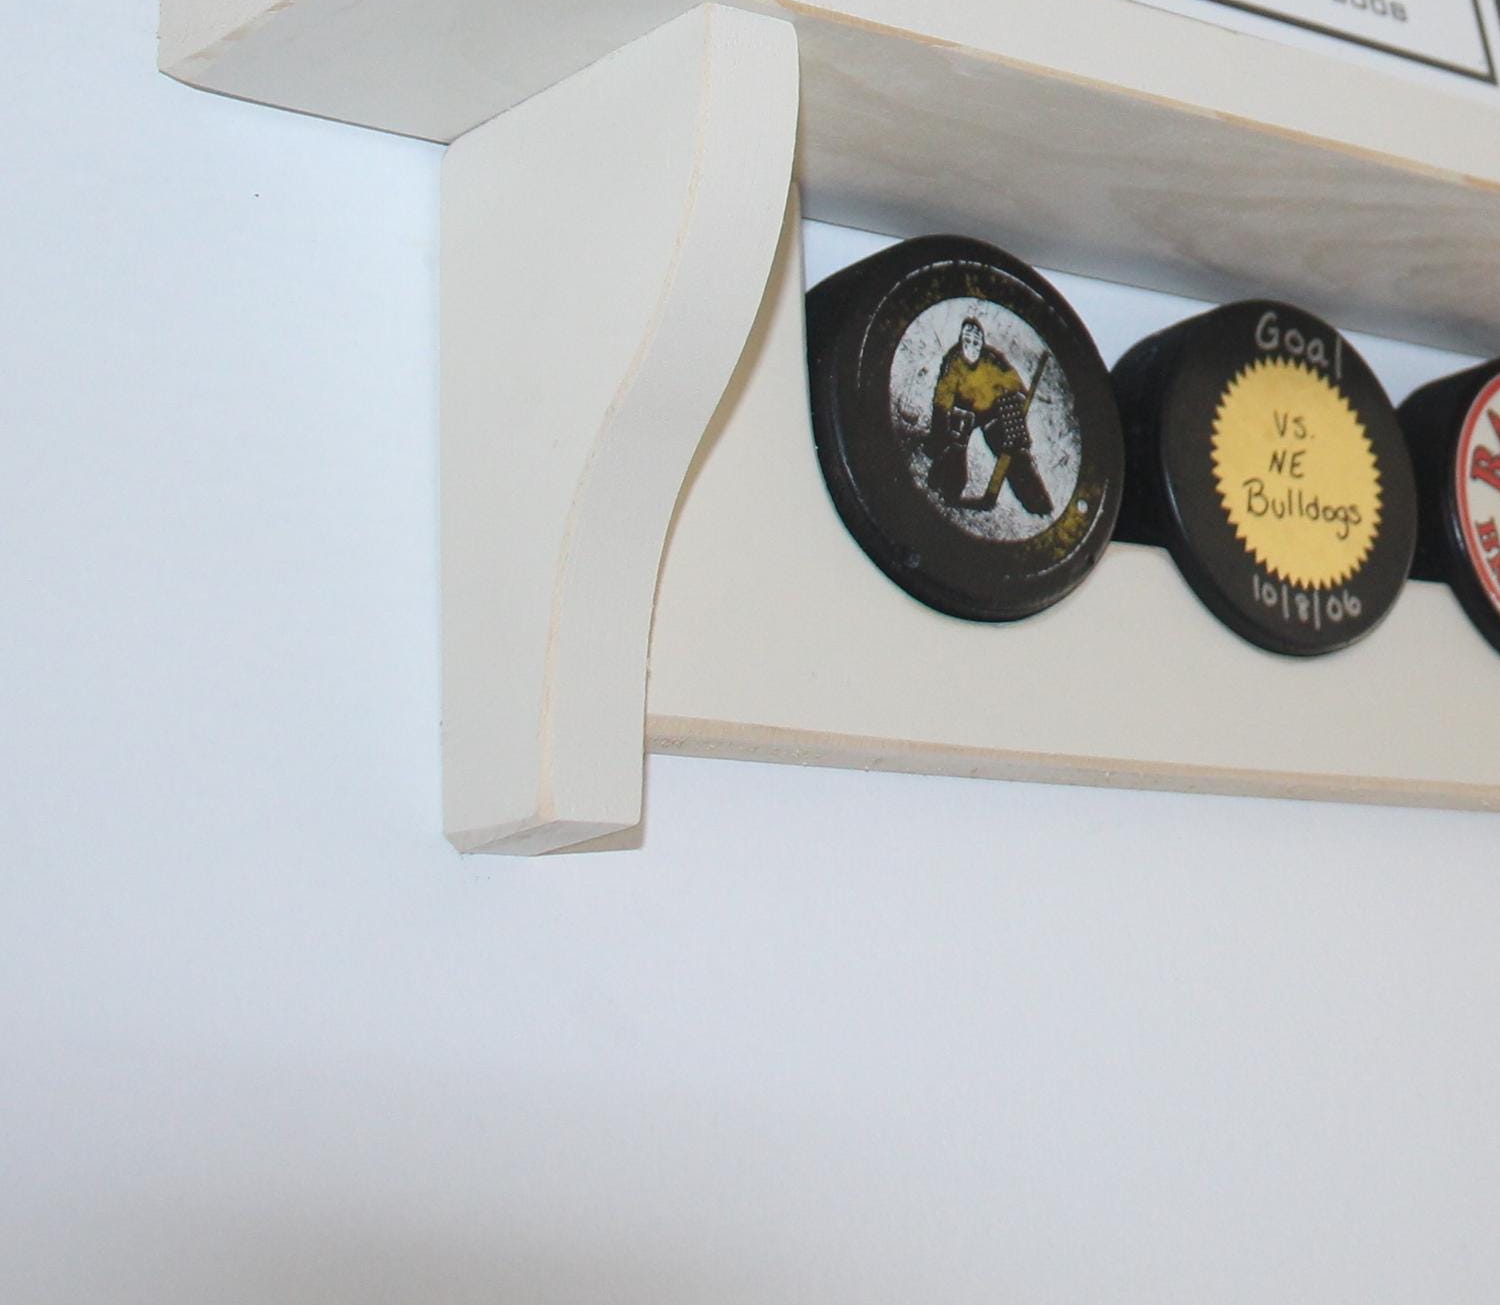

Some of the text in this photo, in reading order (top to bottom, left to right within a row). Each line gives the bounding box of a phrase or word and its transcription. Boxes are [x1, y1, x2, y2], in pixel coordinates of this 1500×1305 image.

[1254, 310, 1344, 382] Goal
[1268, 449, 1307, 480] NE
[1242, 476, 1363, 541] Bulldogs
